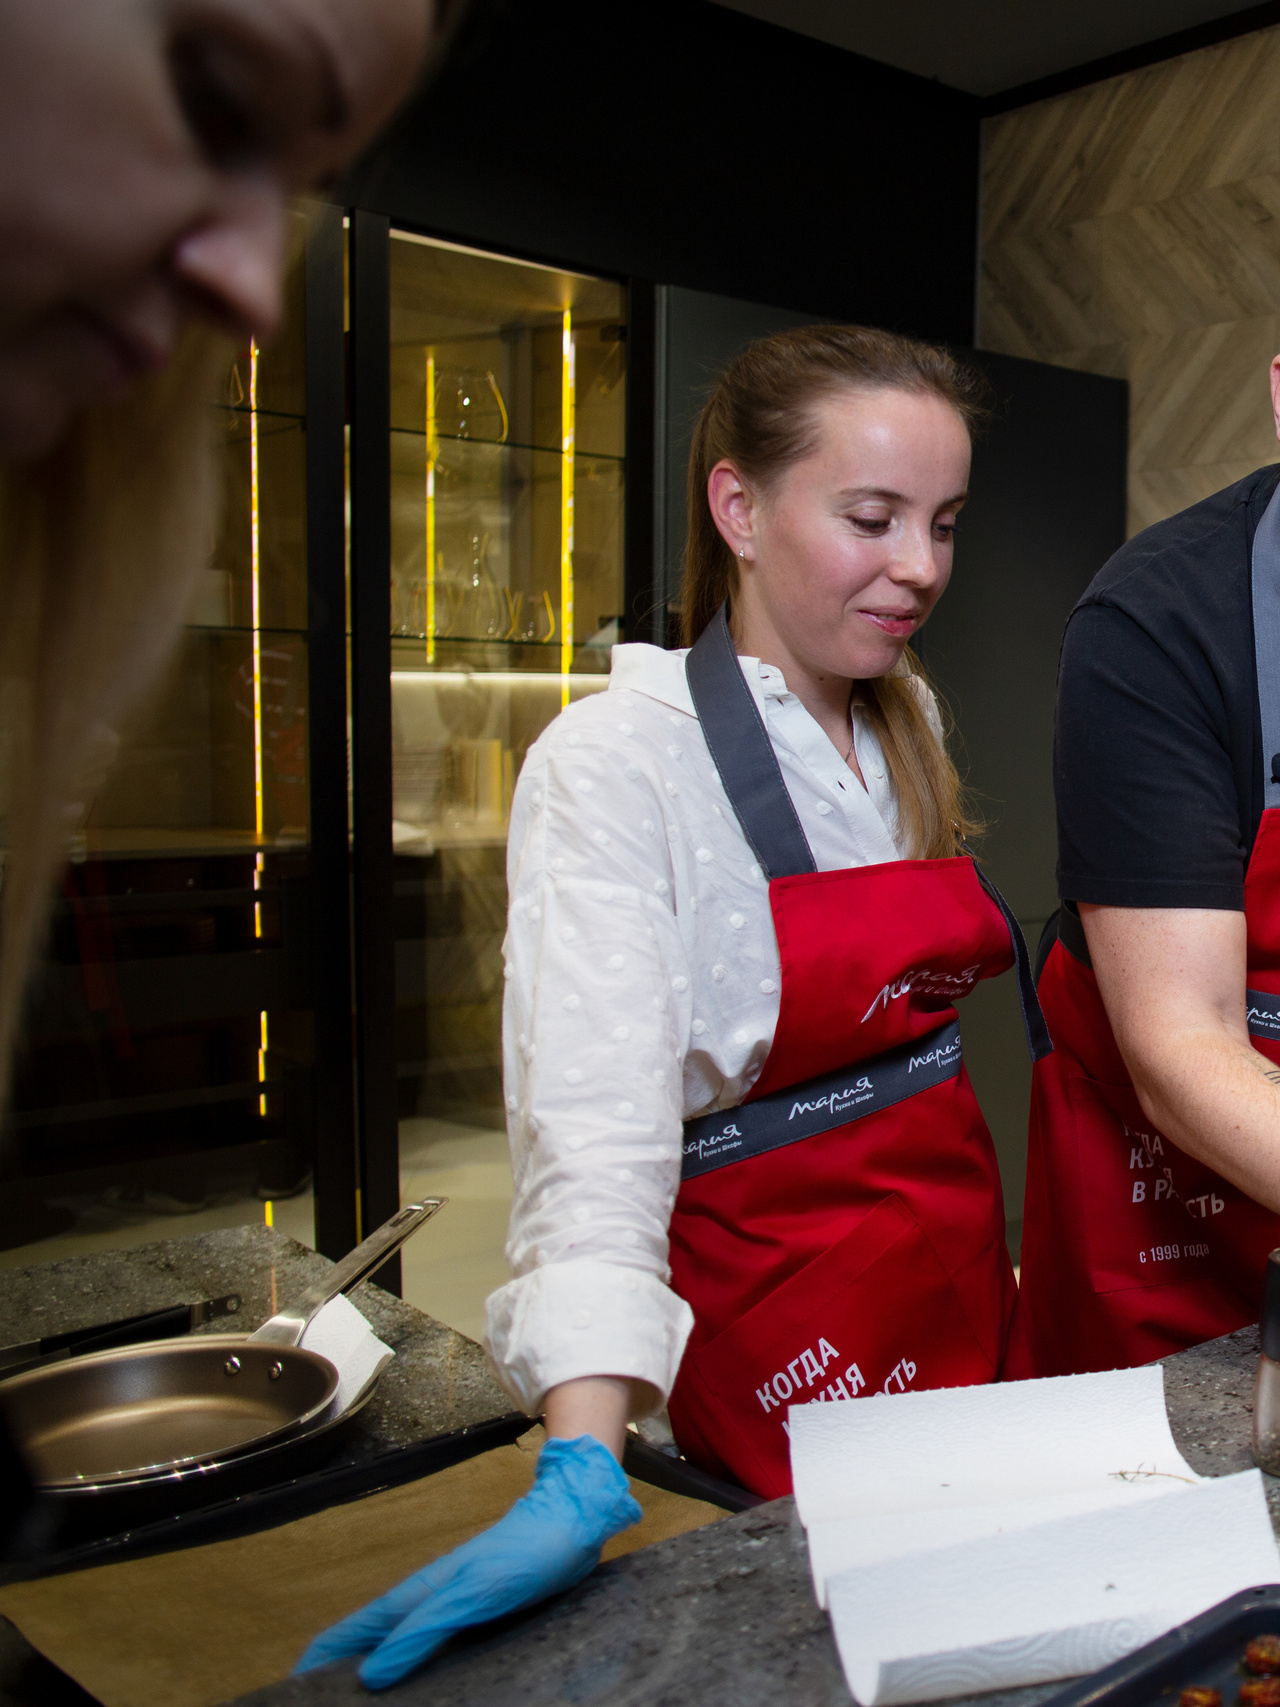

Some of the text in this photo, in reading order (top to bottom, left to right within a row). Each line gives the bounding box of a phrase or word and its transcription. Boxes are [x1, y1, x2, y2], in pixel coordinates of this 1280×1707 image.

[788, 1077, 873, 1120] Мария
[682, 1124, 742, 1160] ария
[1132, 1181, 1146, 1203] В
[1150, 1244, 1180, 1262] 1999
[1184, 1243, 1210, 1258] года
[755, 1337, 840, 1414] КОГДА
